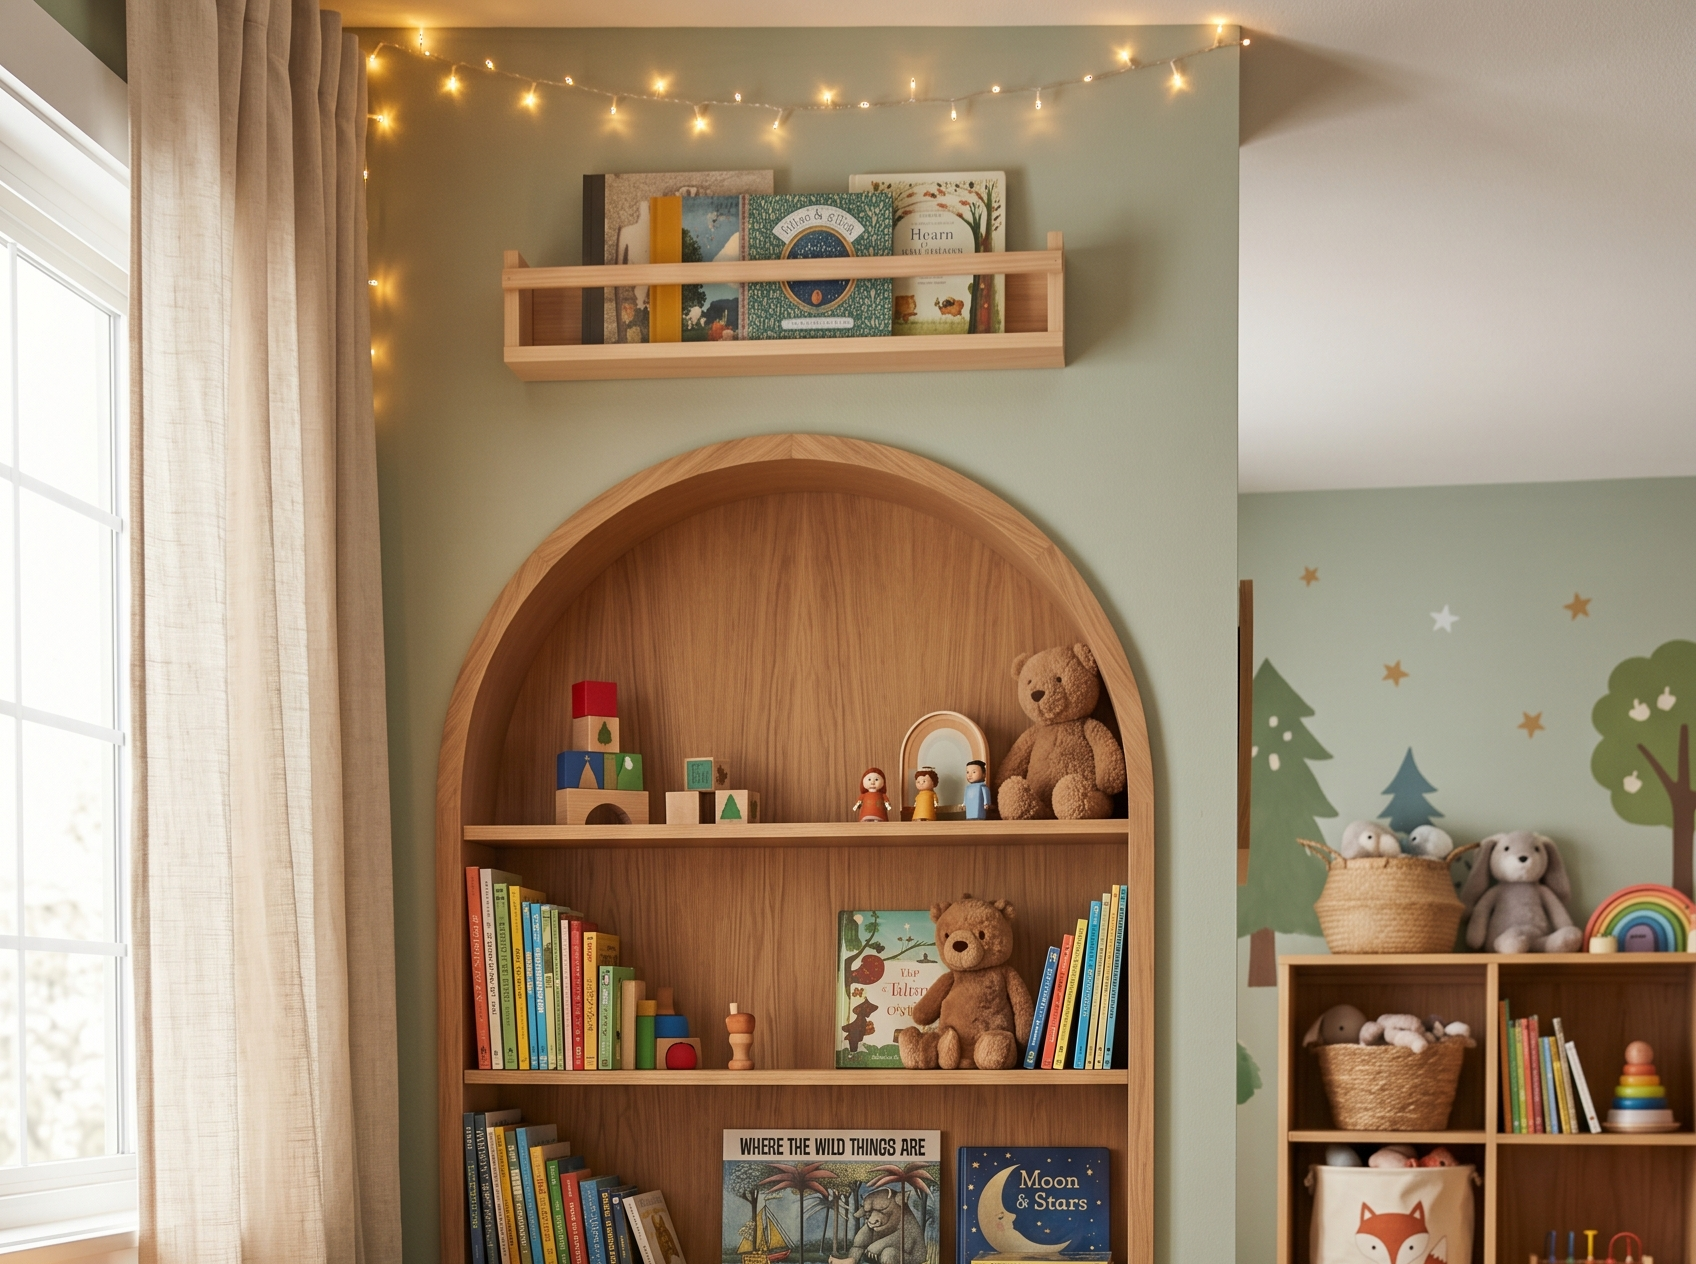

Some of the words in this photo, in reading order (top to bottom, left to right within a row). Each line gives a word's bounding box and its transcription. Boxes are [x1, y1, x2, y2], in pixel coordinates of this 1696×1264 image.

[740, 1137, 784, 1156] WHERE
[787, 1137, 810, 1156] THE
[815, 1137, 845, 1156] WILD
[849, 1137, 896, 1157] THINGS
[900, 1138, 926, 1157] ARE
[1019, 1169, 1080, 1189] Moon
[1016, 1193, 1029, 1209] &
[1034, 1191, 1088, 1211] Stars
